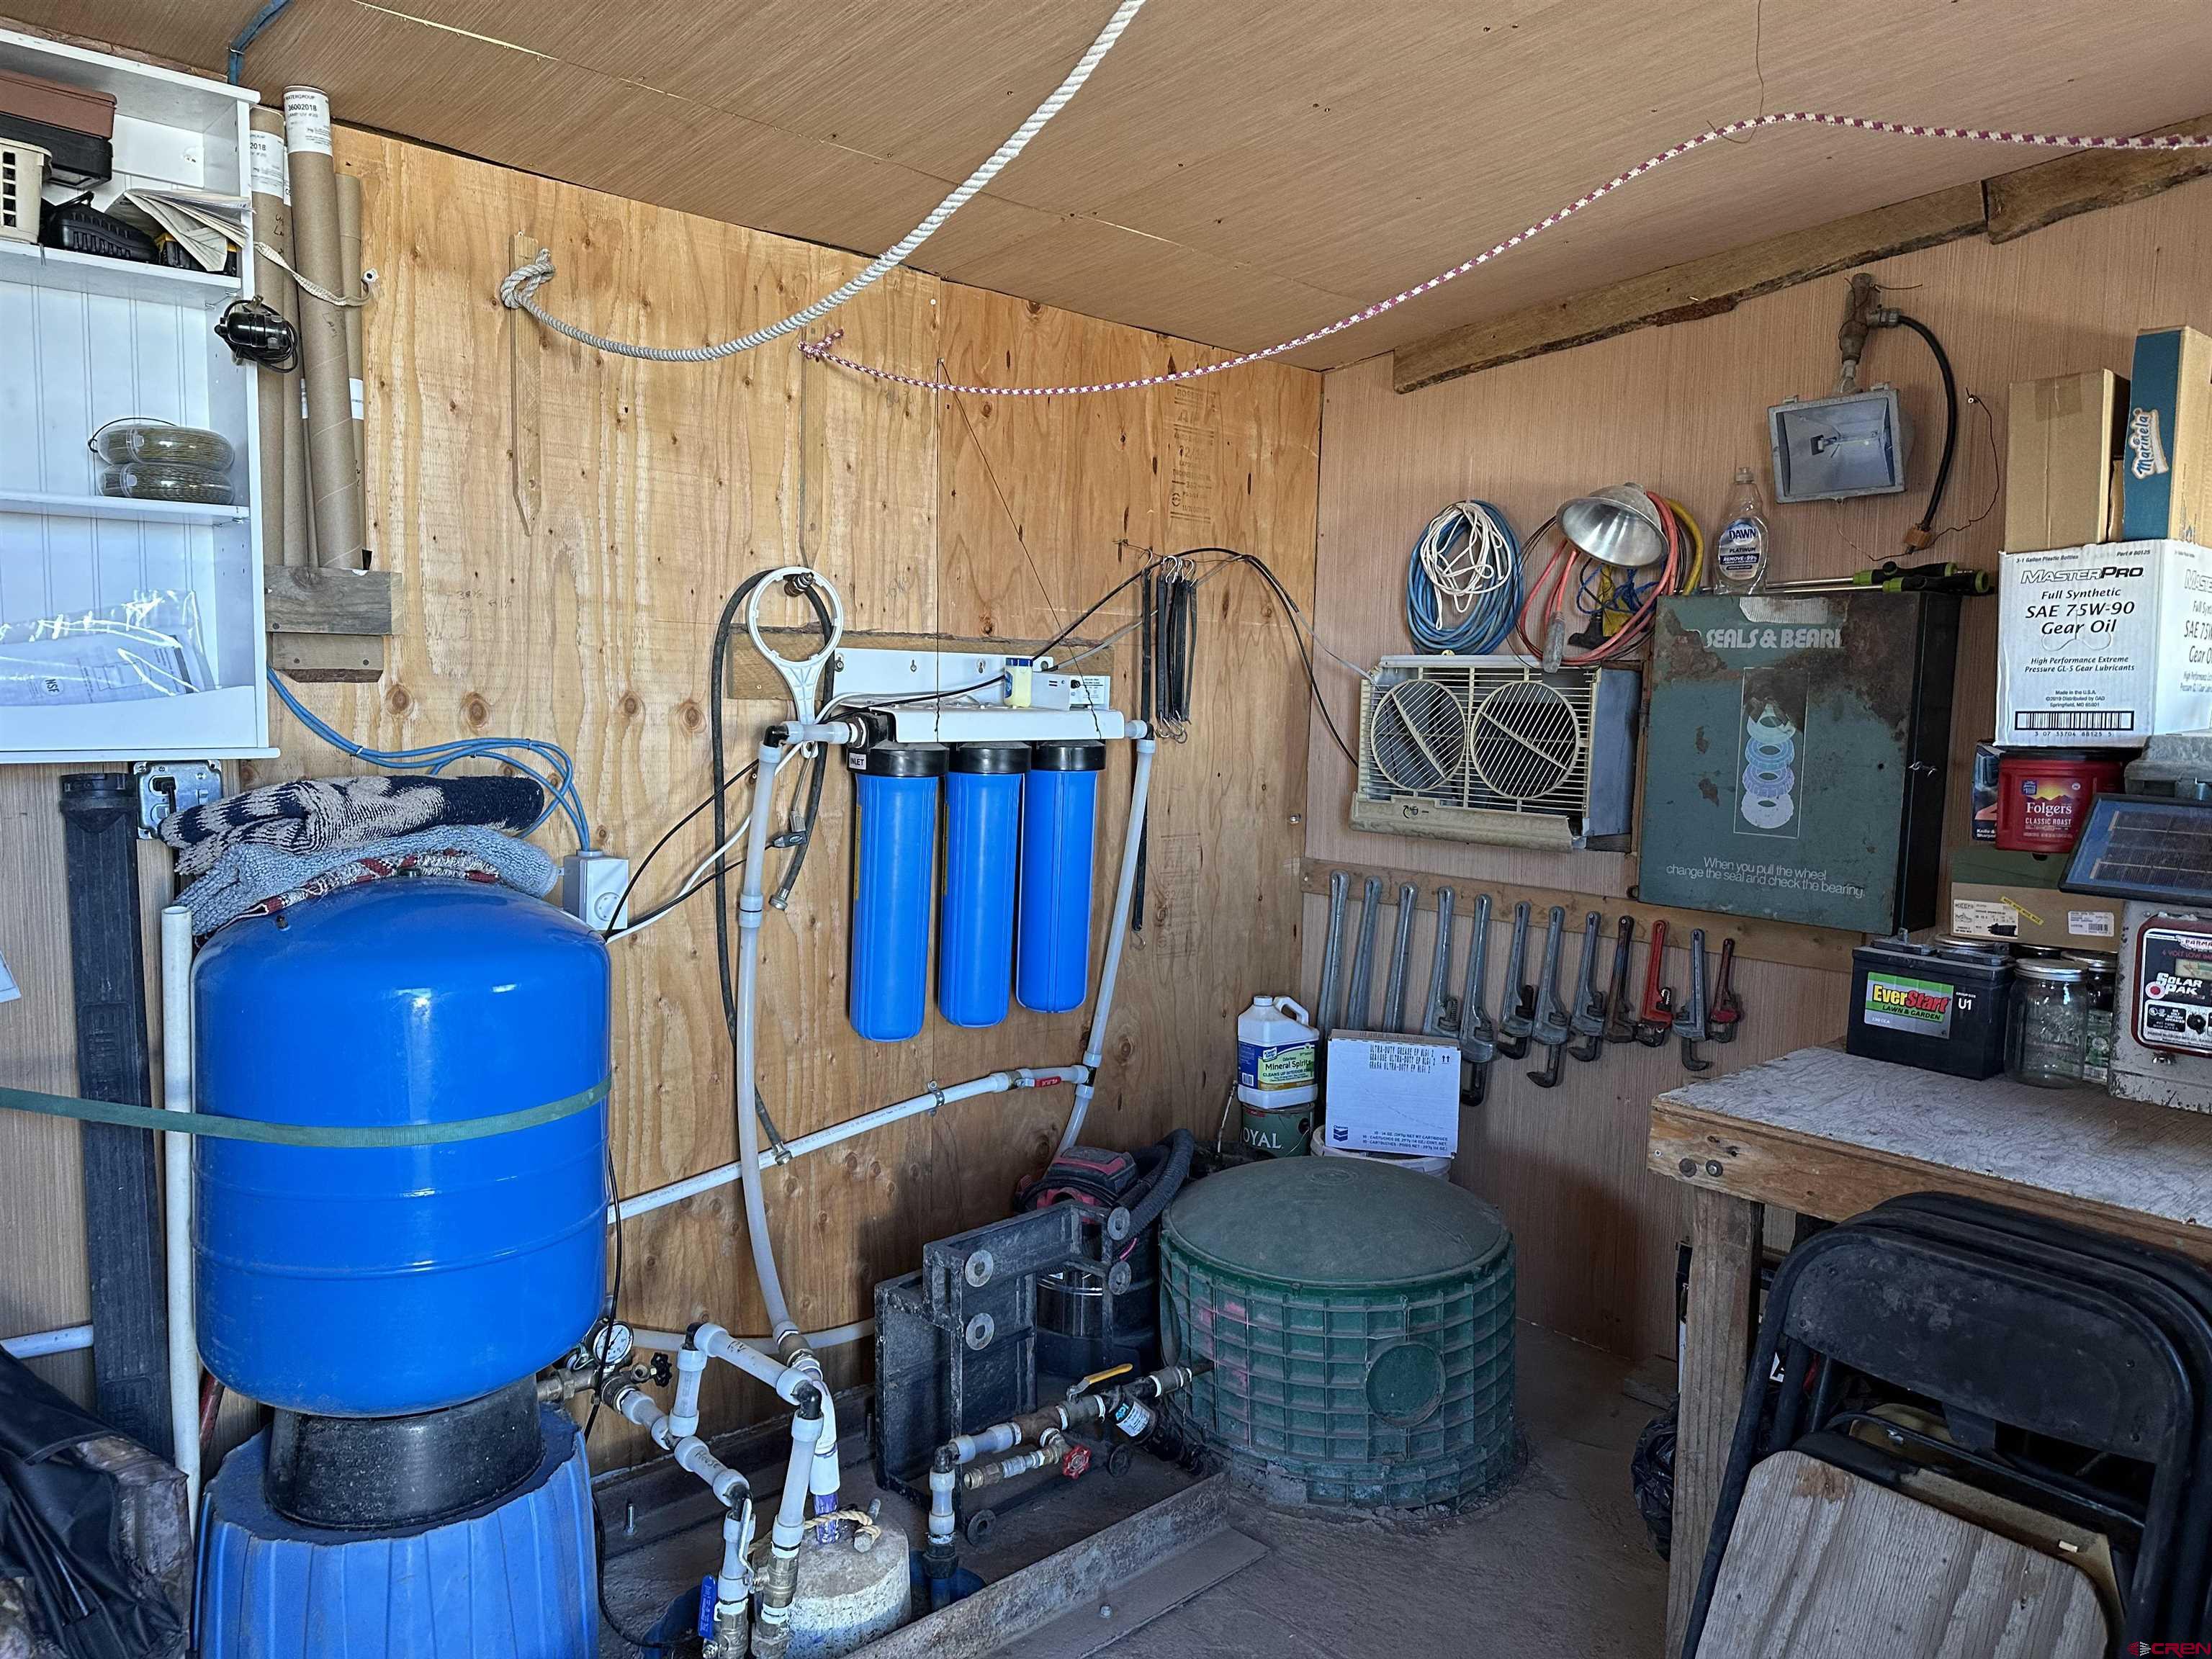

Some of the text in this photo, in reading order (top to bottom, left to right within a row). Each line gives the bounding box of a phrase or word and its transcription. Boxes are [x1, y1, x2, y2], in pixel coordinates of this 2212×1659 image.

[2133, 414, 2154, 475] Marinela
[1729, 529, 1756, 539] DAWN
[2020, 566, 2144, 584] MASTERPRO
[2041, 588, 2121, 600] Full Synthetic
[2026, 601, 2135, 619] SAE 75W-90
[2041, 619, 2117, 635] Gear Oil
[2184, 620, 2199, 639] SAE
[1705, 629, 1758, 649] SEALS
[1759, 629, 1777, 649] &
[2189, 645, 2205, 663] Gear
[45, 678, 60, 693] NSF
[850, 757, 864, 765] INLET
[2026, 802, 2072, 817] Folgers
[1704, 857, 1827, 881] When you pull the wheel
[1666, 865, 1866, 899] change the seal and check the bearing.
[2156, 972, 2203, 988] SOLAR
[2165, 983, 2198, 995] PAK
[1873, 984, 1948, 1014] EverStart
[1958, 998, 1972, 1010] U1
[1882, 1004, 1903, 1014] LAWN
[1910, 1010, 1941, 1020] GARDEN
[1398, 1046, 1412, 1056] GREASE
[1265, 1060, 1311, 1070] Mineral Spirits
[1243, 1127, 1282, 1149] OYAL
